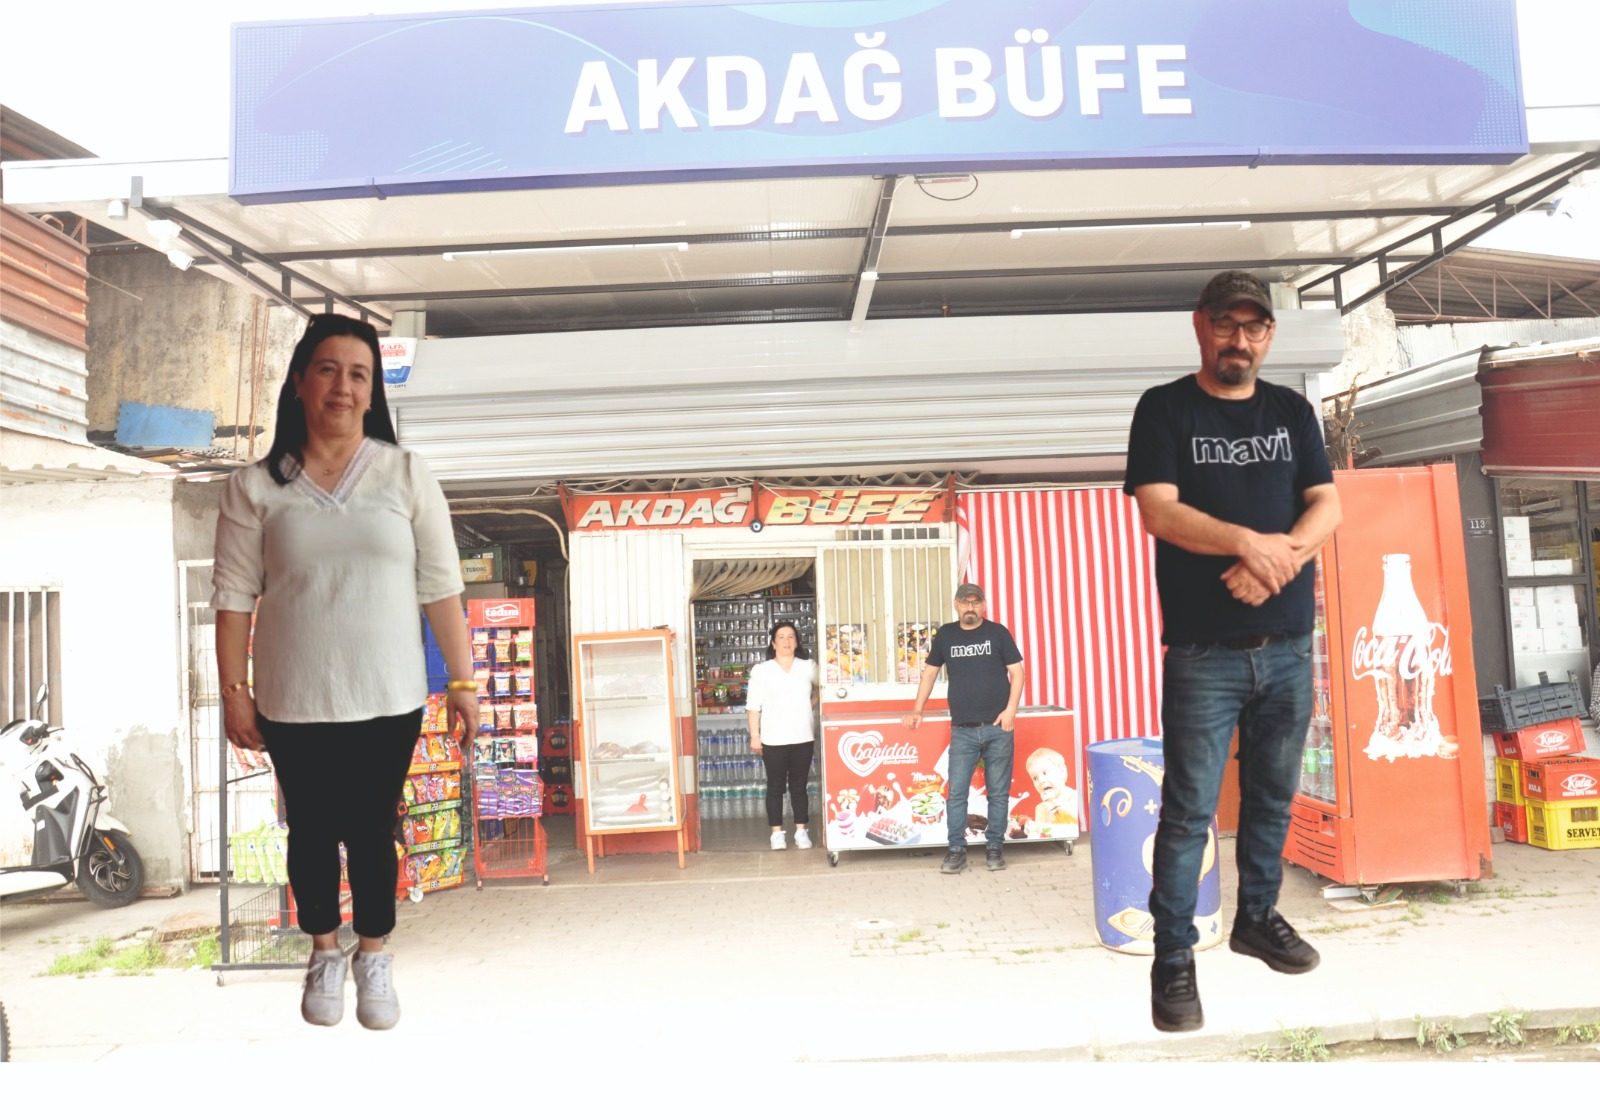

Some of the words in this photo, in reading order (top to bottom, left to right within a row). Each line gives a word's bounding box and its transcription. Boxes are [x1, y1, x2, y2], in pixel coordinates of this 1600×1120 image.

[564, 31, 903, 134] AKDAĞ
[936, 27, 1193, 119] BÜFE
[1192, 426, 1292, 466] mavi
[576, 492, 749, 528] AKDAĞ
[764, 489, 937, 526] BÜFE
[950, 639, 992, 658] mavi
[1540, 732, 1564, 746] Kula
[1567, 776, 1592, 789] Kula
